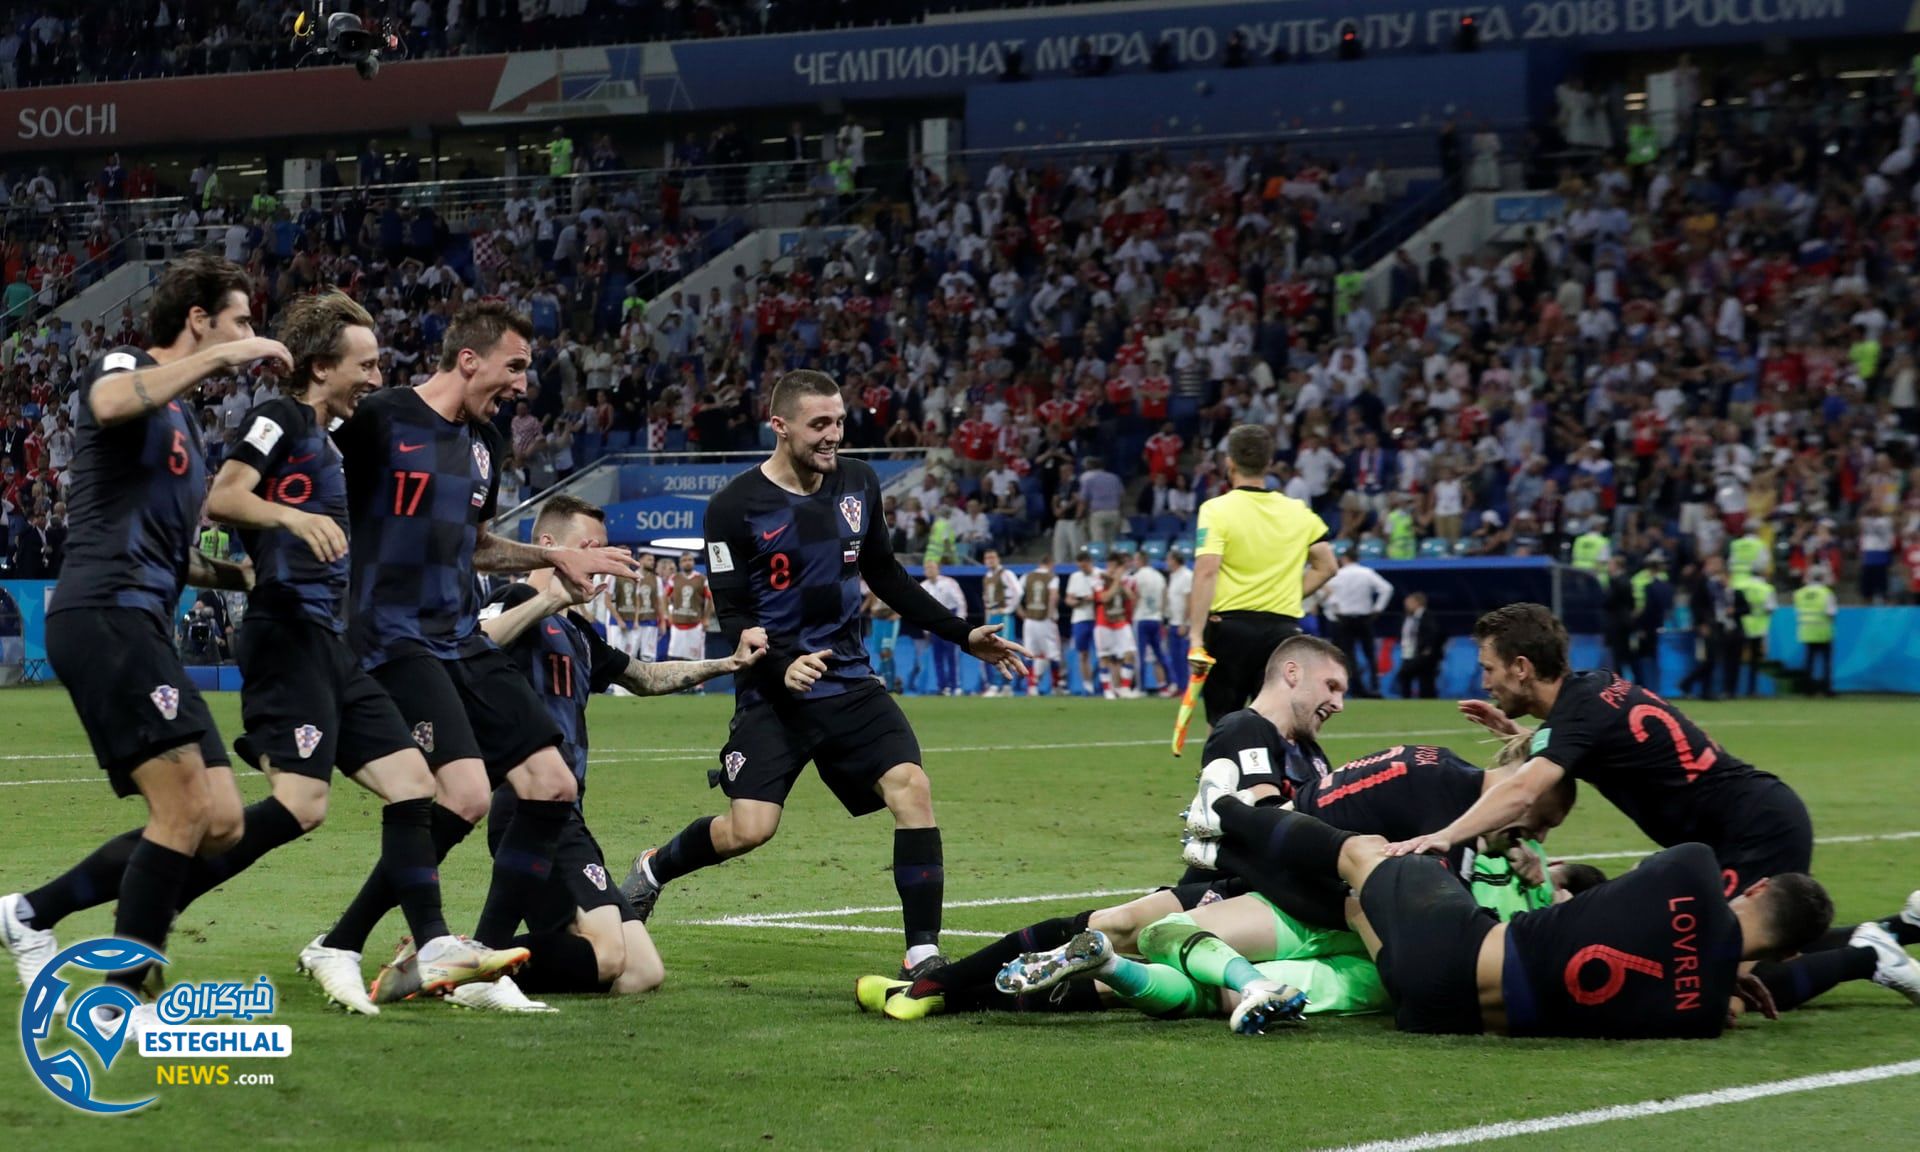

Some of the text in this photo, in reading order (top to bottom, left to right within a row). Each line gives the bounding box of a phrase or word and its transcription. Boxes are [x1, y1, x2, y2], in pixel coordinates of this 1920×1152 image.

[794, 39, 1027, 85] ЧЕМПИОНАТ
[1521, 1, 1618, 39] 2018
[17, 103, 117, 139] SOCHI
[168, 431, 189, 475] 5
[266, 472, 313, 504] 10
[393, 471, 430, 516] 17
[663, 475, 697, 491] 2018
[636, 510, 694, 530] SOCHI
[770, 553, 792, 590] 8
[550, 654, 573, 698] 11
[1629, 690, 1719, 783] 2
[1564, 943, 1664, 1006] 6
[1668, 896, 1700, 1012] LOVREN
